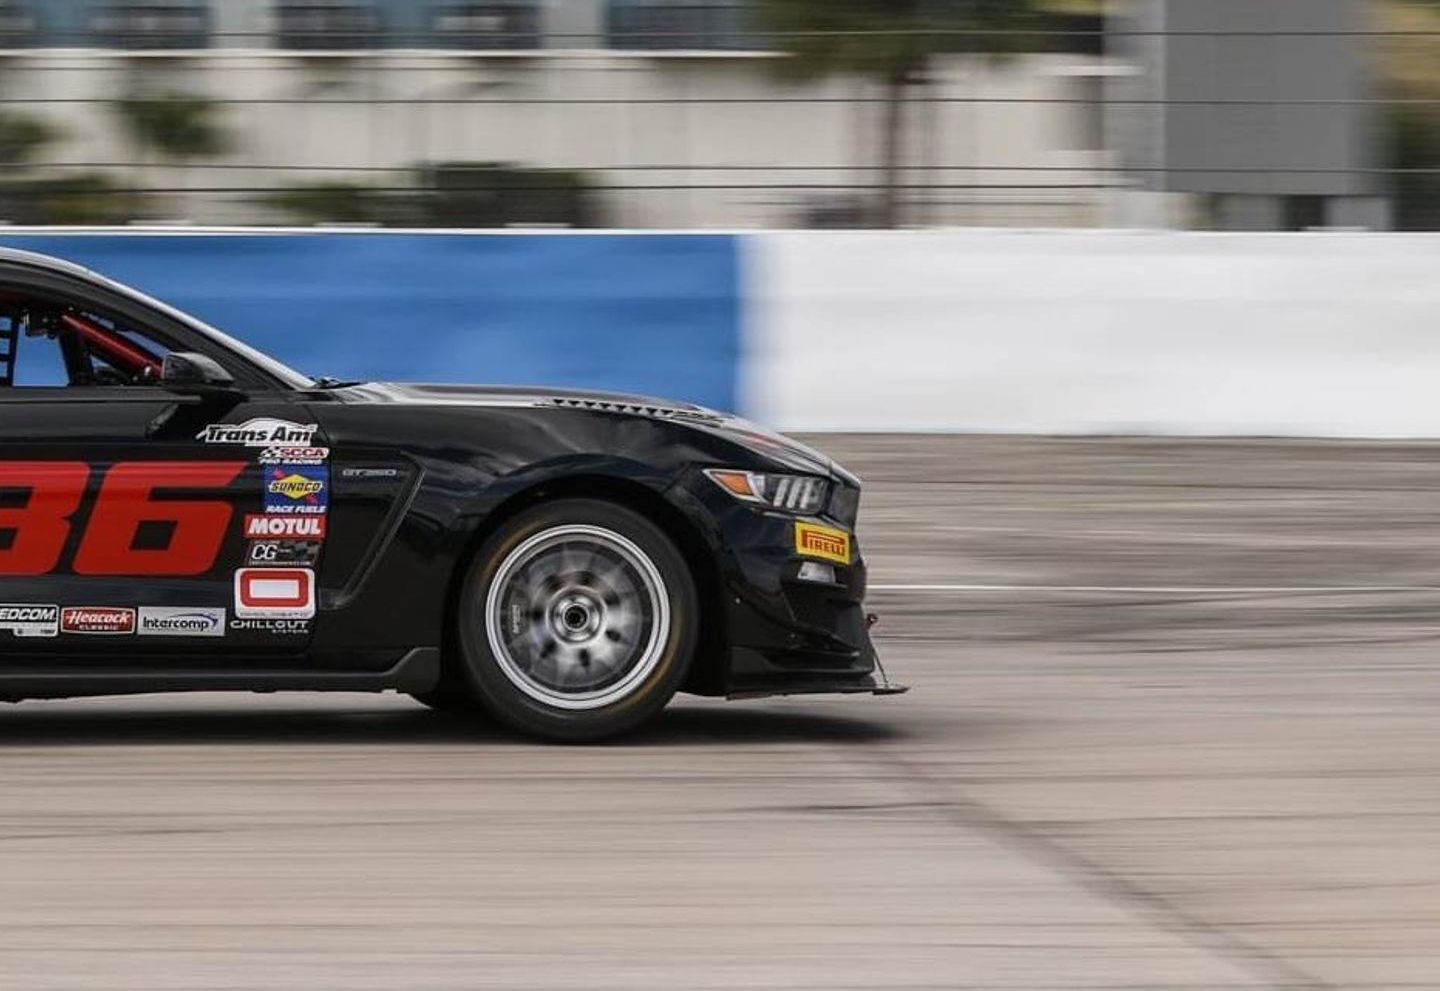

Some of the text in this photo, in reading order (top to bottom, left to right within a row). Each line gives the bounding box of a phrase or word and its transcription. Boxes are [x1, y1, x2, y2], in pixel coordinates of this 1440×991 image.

[206, 426, 309, 442] Trans Am
[280, 447, 325, 457] SCCA
[271, 482, 321, 492] SUNOCO
[247, 518, 321, 535] MOTUL
[802, 529, 846, 557] PIRELLI
[251, 544, 278, 560] CG
[142, 616, 209, 632] Intercomp
[230, 619, 309, 629] CHILLOUT
